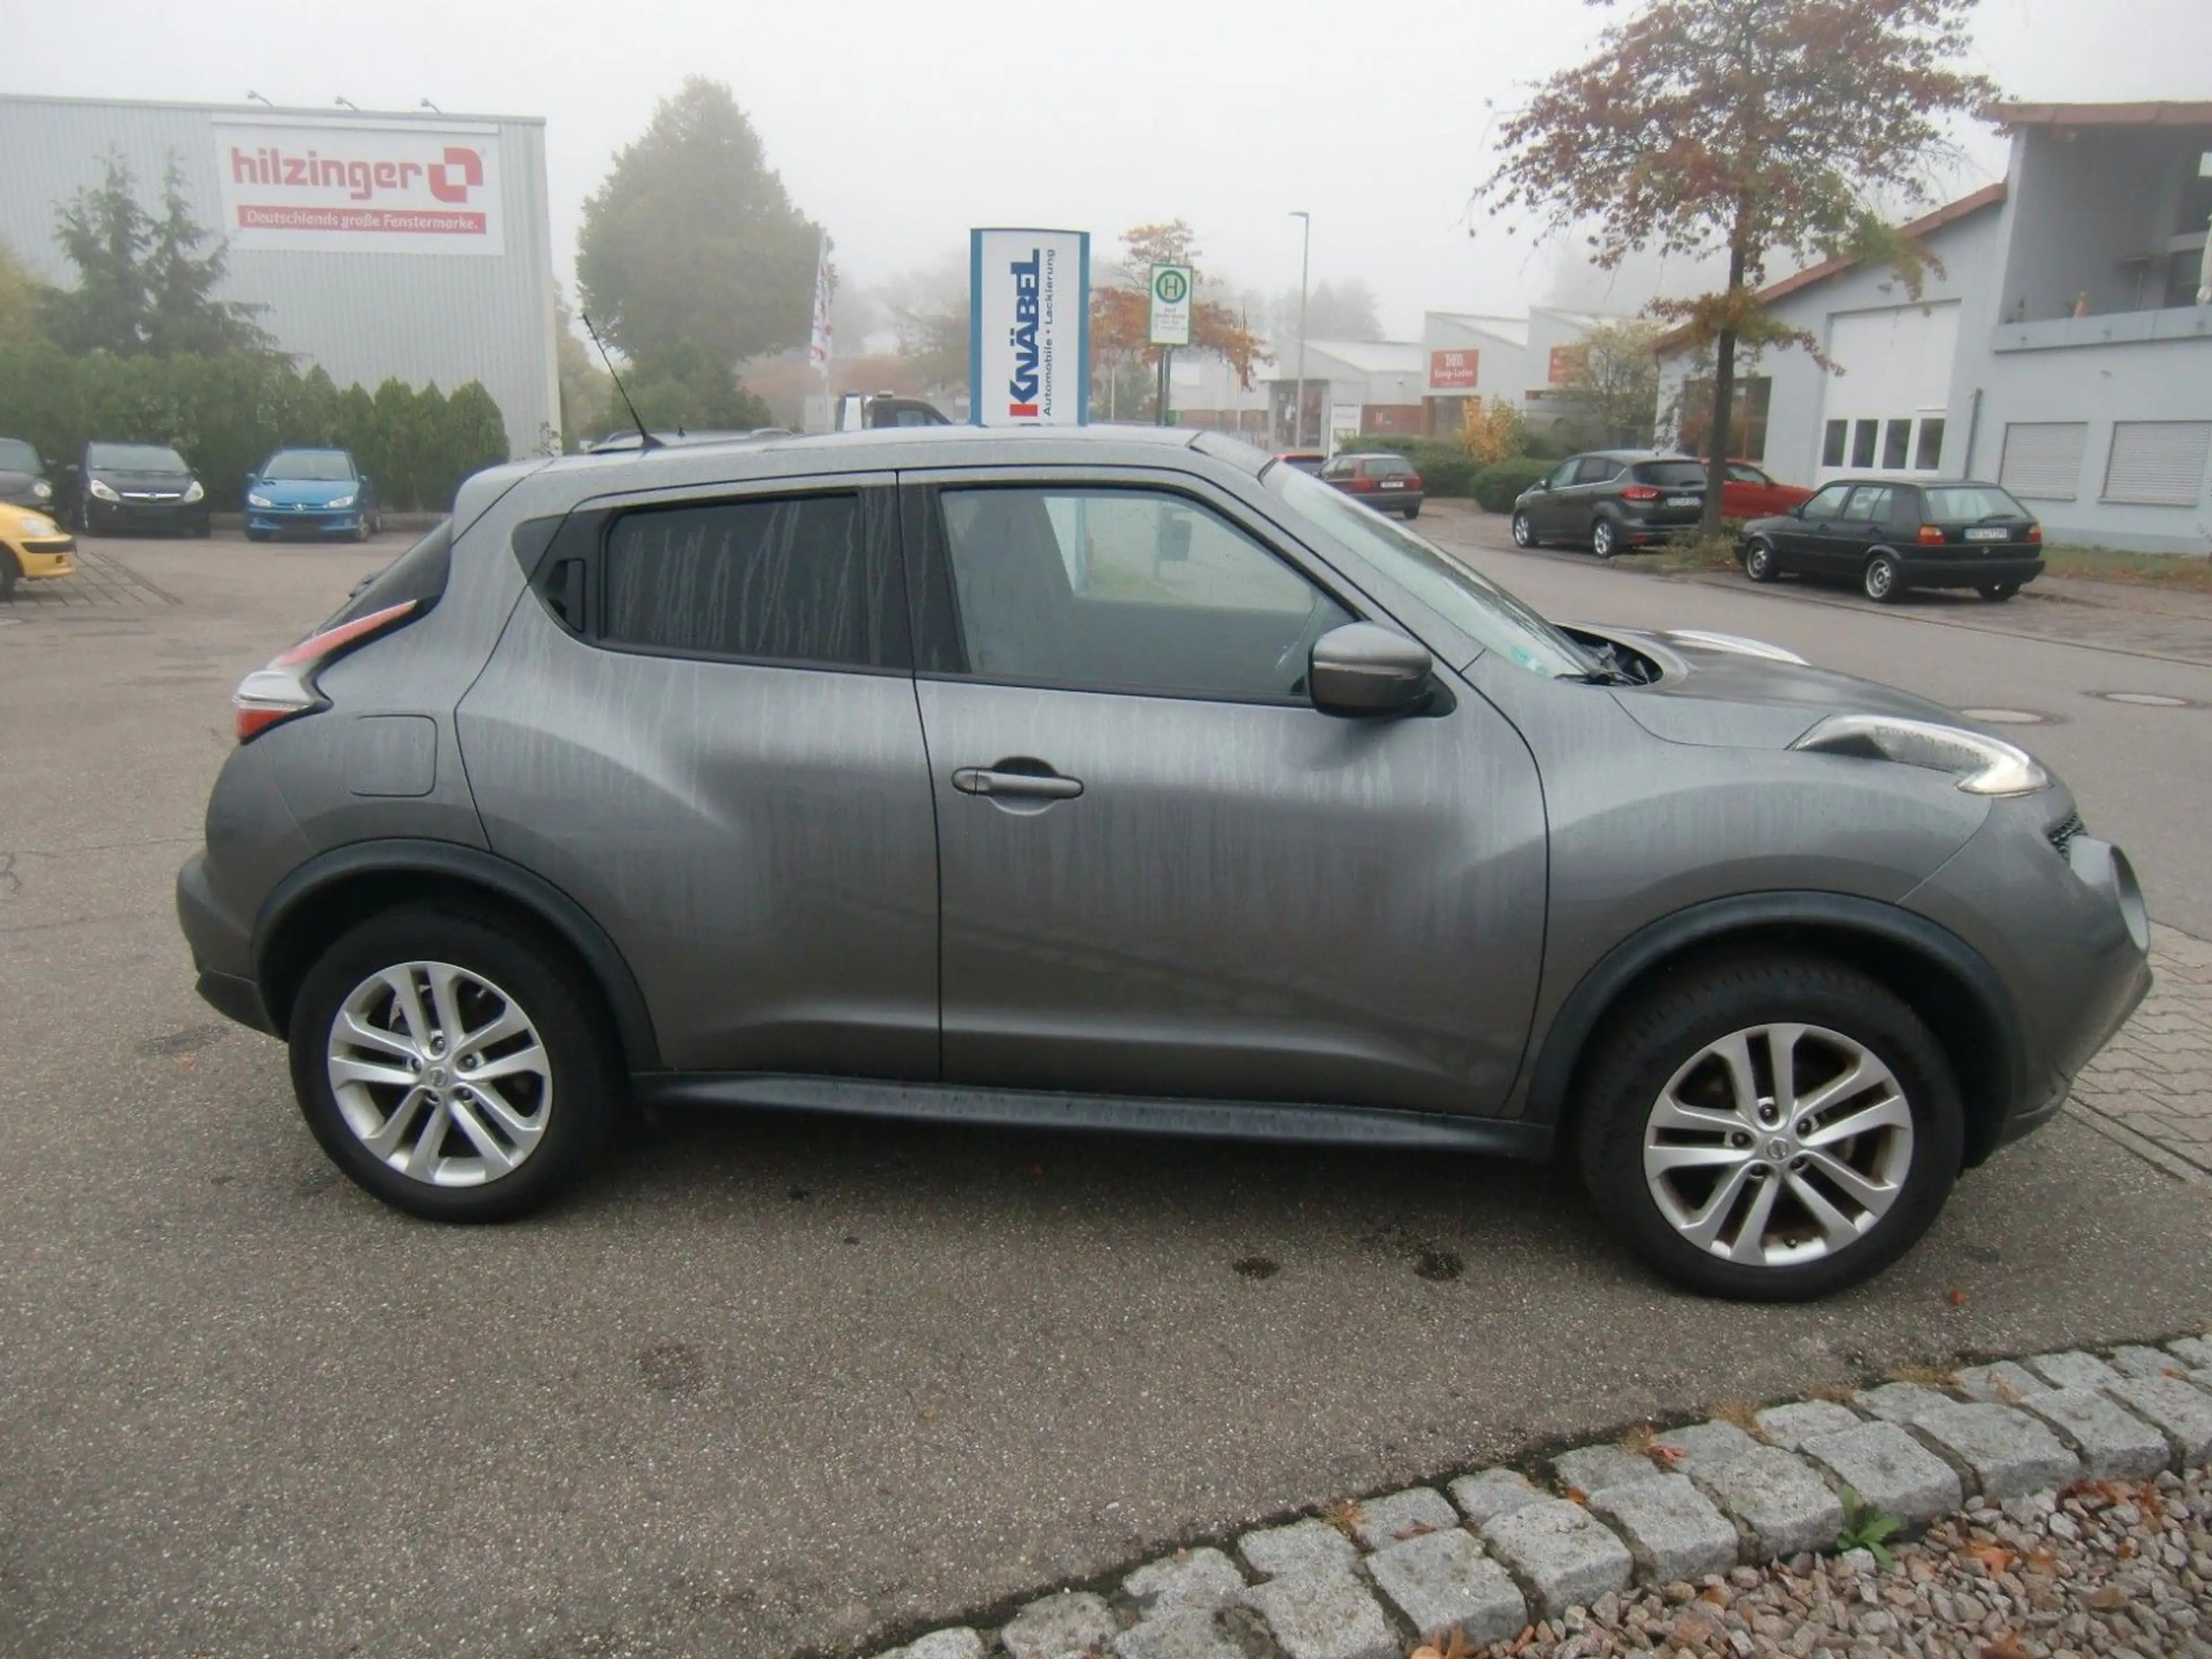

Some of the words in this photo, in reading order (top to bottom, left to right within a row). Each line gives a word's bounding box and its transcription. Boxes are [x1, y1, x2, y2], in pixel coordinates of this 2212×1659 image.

[231, 147, 423, 200] hilzinger
[247, 210, 339, 225] Deutschlands
[341, 213, 380, 229] große
[1044, 249, 1056, 325] Lackierung
[1164, 278, 1177, 297] H
[1009, 248, 1040, 416] KNÄBEL
[1043, 339, 1053, 416] Automobile
